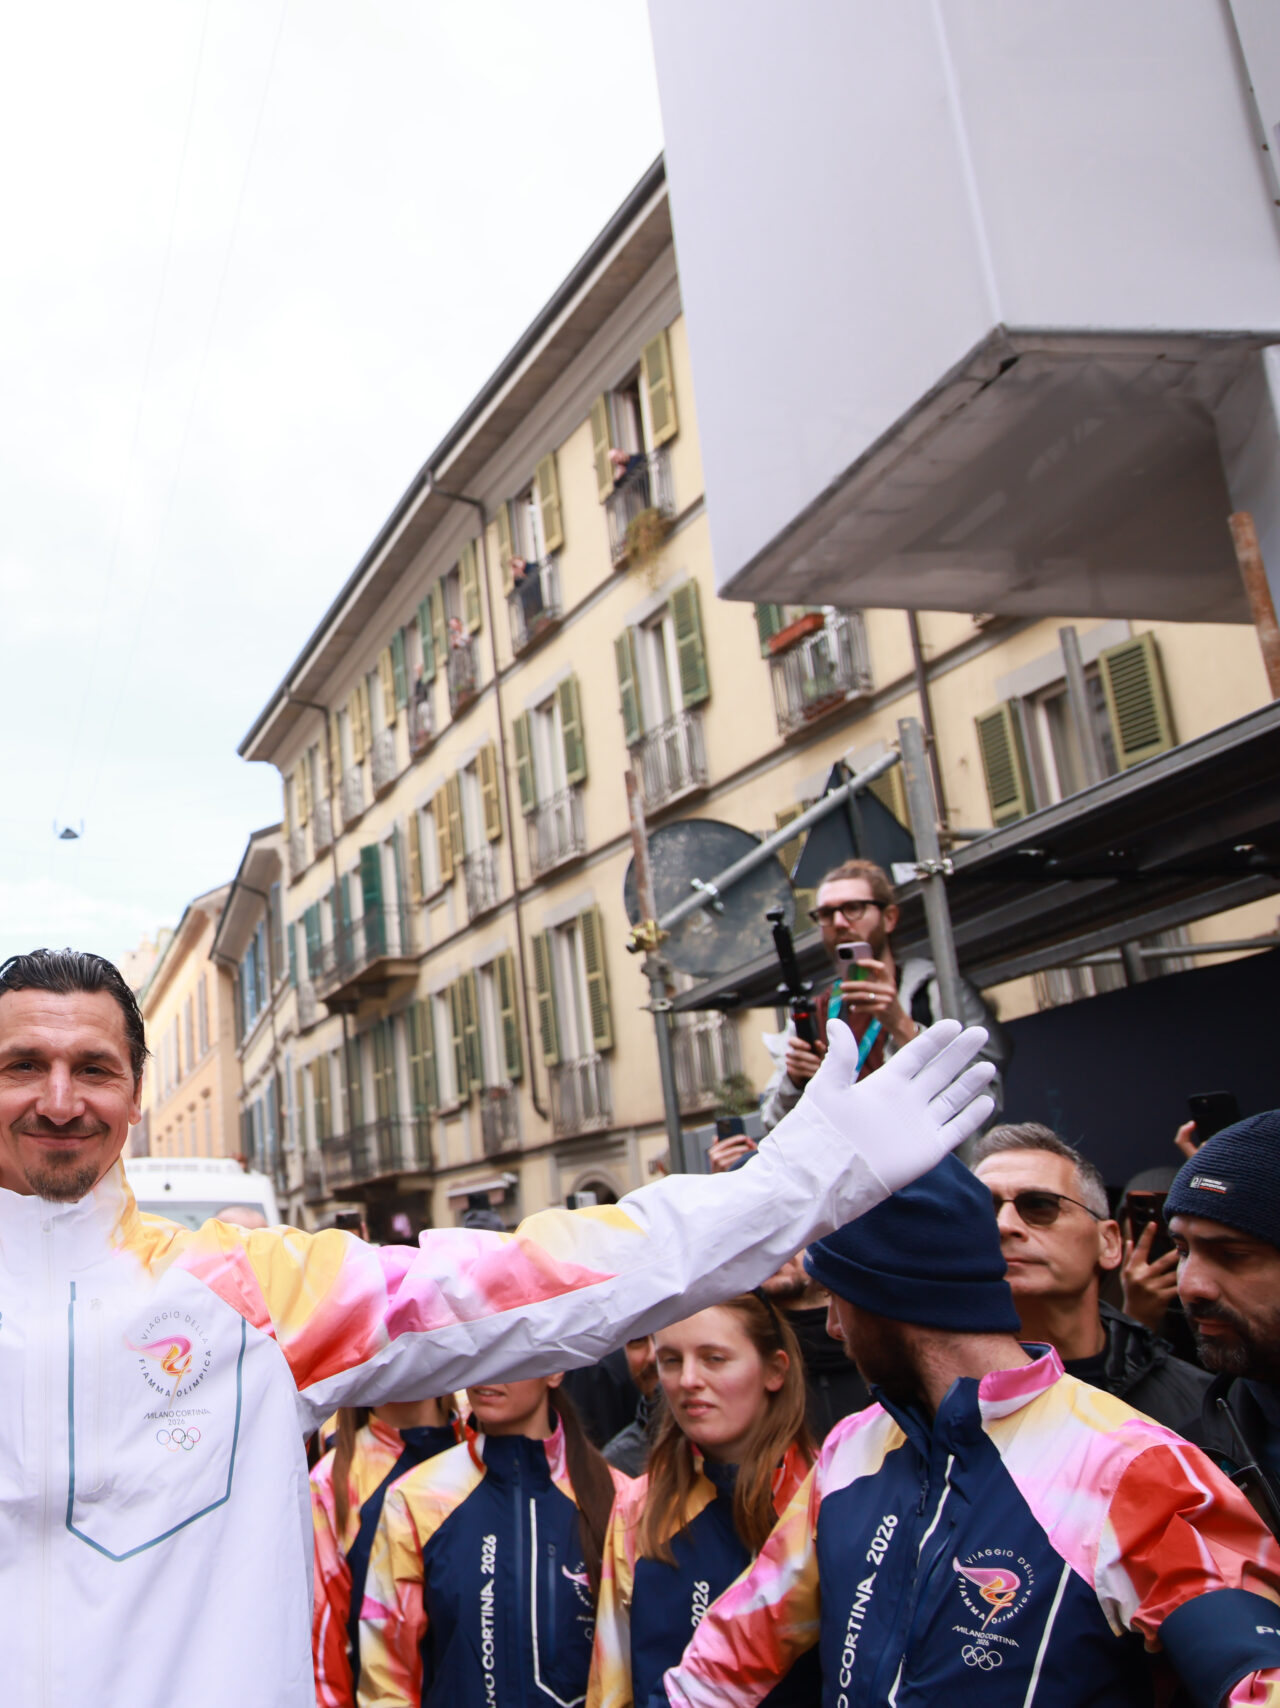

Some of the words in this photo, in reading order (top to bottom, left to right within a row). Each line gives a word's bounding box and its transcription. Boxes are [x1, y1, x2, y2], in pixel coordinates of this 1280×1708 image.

[141, 1311, 180, 1340] VIAGGIO
[185, 1314, 208, 1344] DELLA
[138, 1358, 171, 1397] FIAMMA
[176, 1350, 212, 1397] OLIMPICA
[143, 1410, 174, 1420] MILANO
[480, 1533, 497, 1575] 2026
[965, 1548, 1014, 1565] VIAGGIO
[1017, 1556, 1035, 1586] DELLA
[839, 1572, 877, 1688] CORTINA
[866, 1514, 899, 1566] 2026
[958, 1577, 986, 1621] FIAMMA
[480, 1578, 495, 1671] CORTINA
[984, 1633, 1020, 1648] CORTINA
